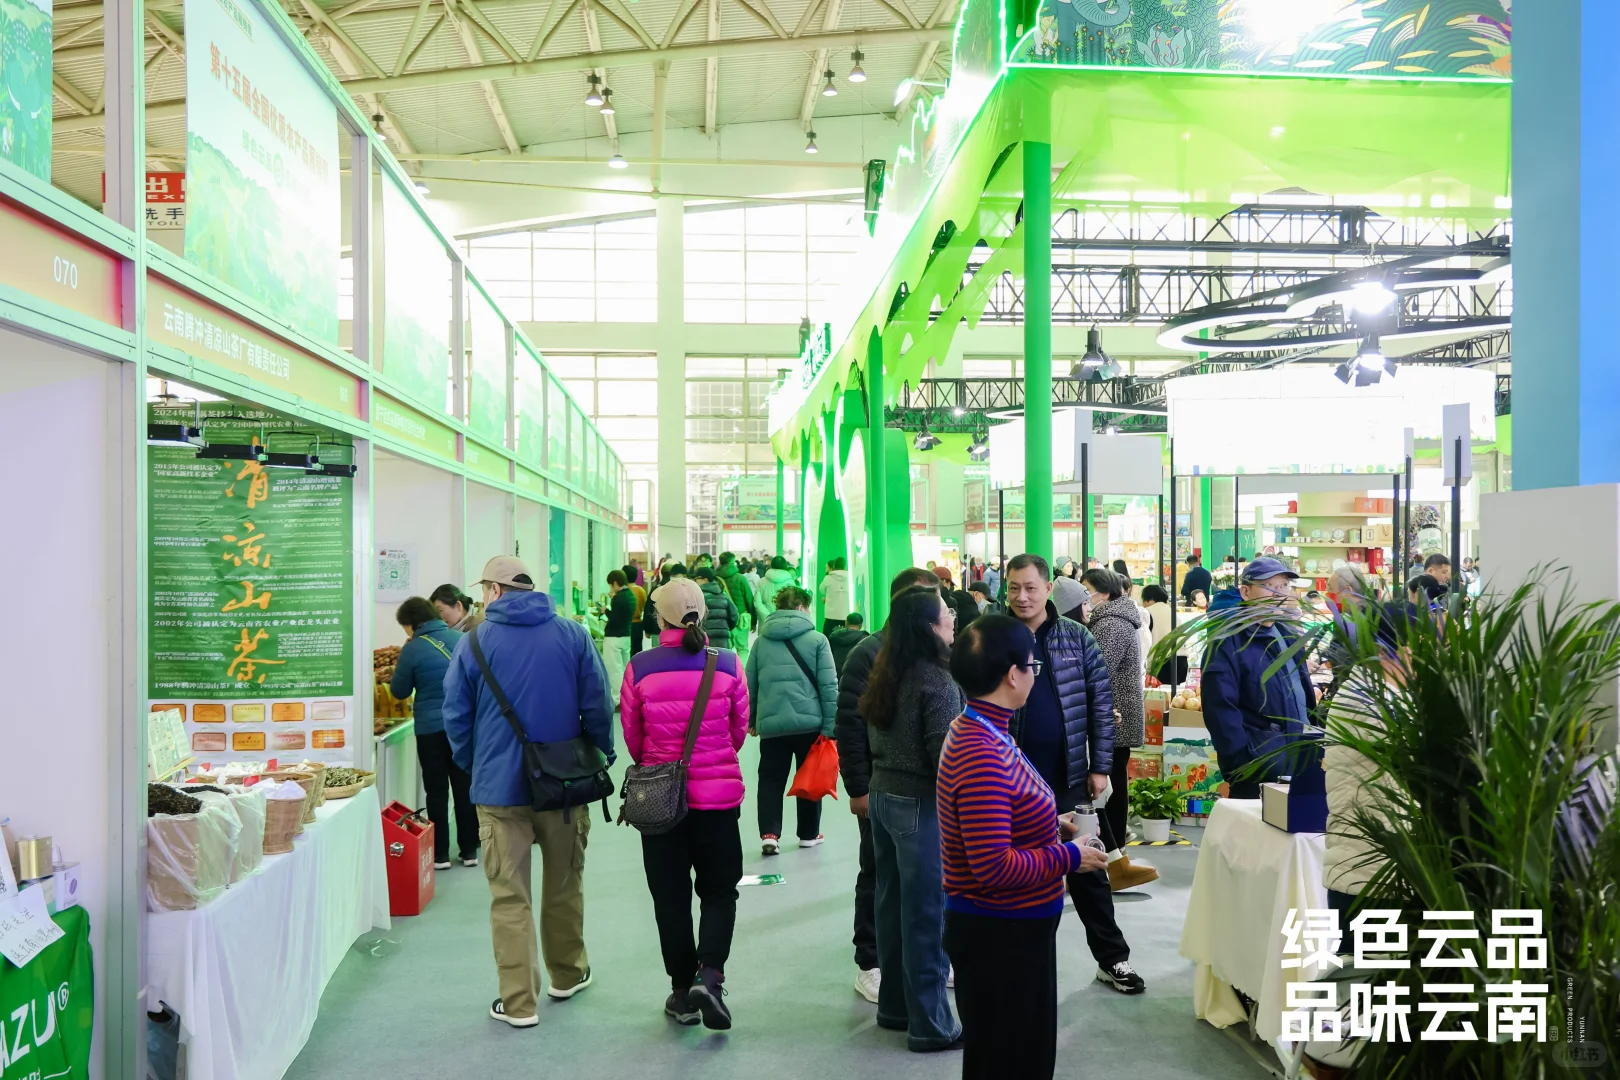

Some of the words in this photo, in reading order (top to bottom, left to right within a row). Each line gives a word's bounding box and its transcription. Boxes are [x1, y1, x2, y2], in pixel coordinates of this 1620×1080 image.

[146, 177, 185, 193] 出
[53, 255, 79, 290] 070
[163, 302, 290, 380] 云南腾冲清凉山茶厂有限责任公司
